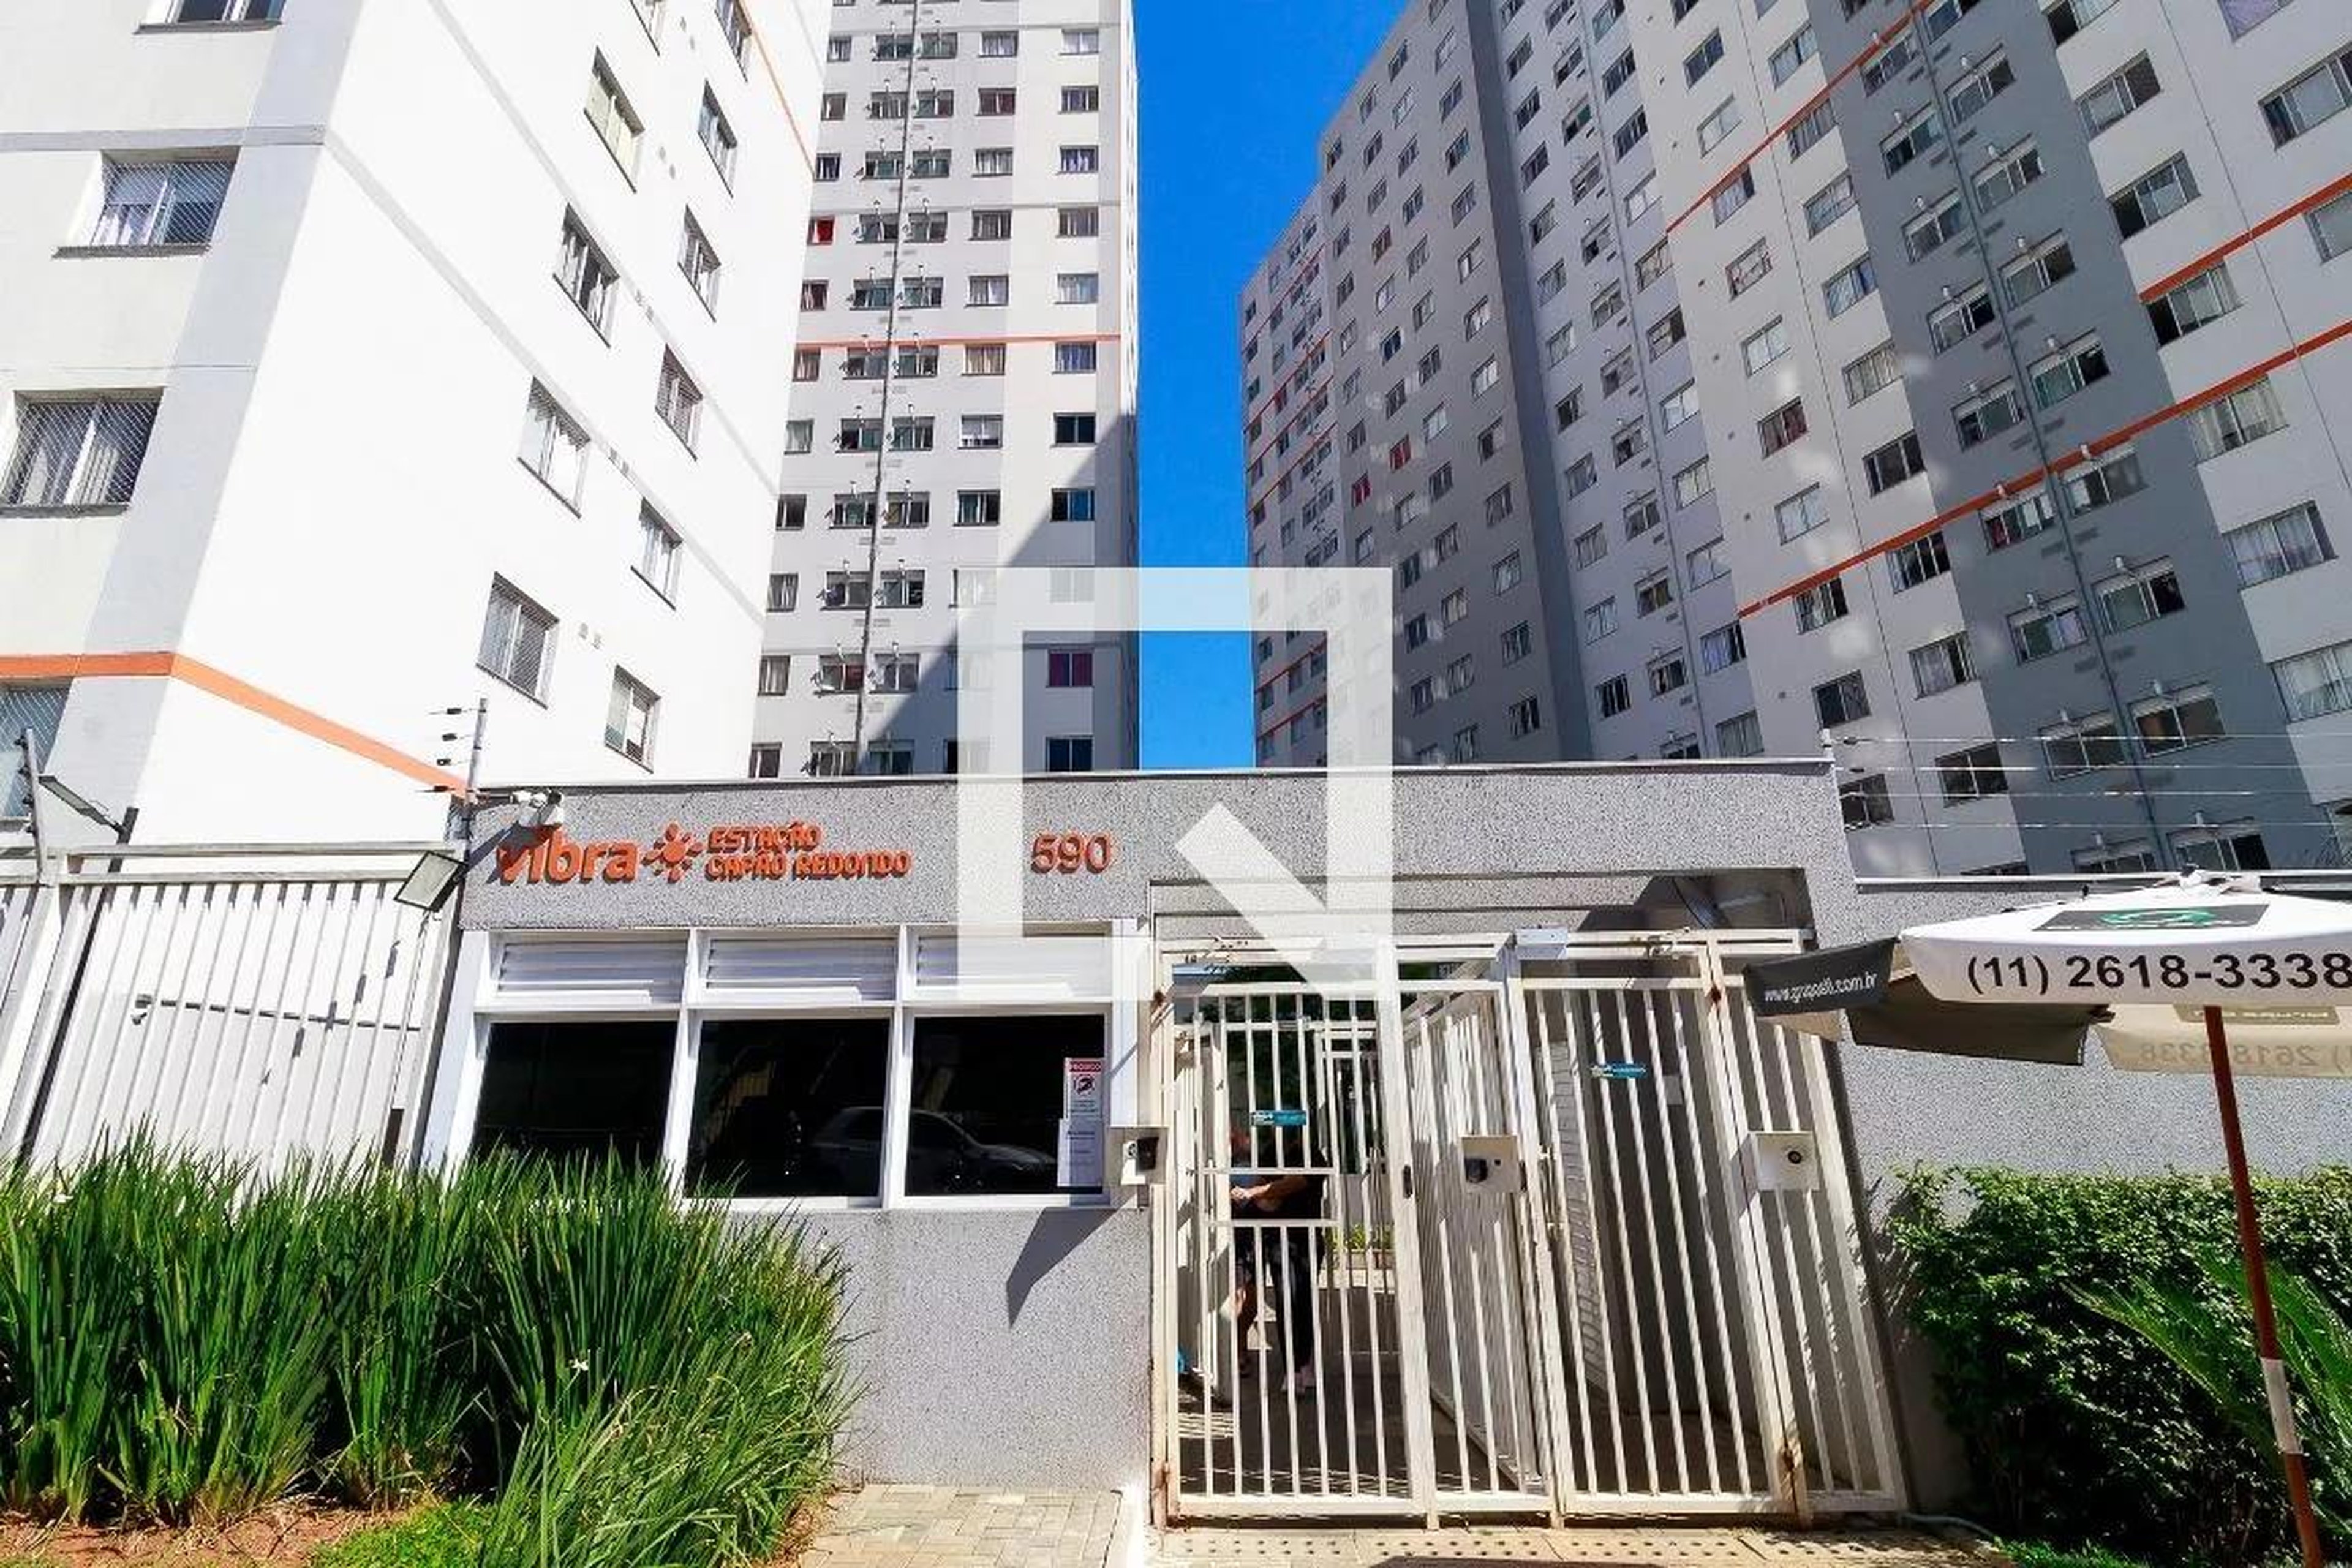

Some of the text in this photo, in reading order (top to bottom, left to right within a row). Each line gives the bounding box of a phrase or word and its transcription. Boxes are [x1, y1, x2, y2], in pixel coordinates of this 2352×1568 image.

[792, 850, 911, 880] REDONDO
[1031, 832, 1114, 874] 590
[1968, 953, 2352, 995] (11) 2618-3338
